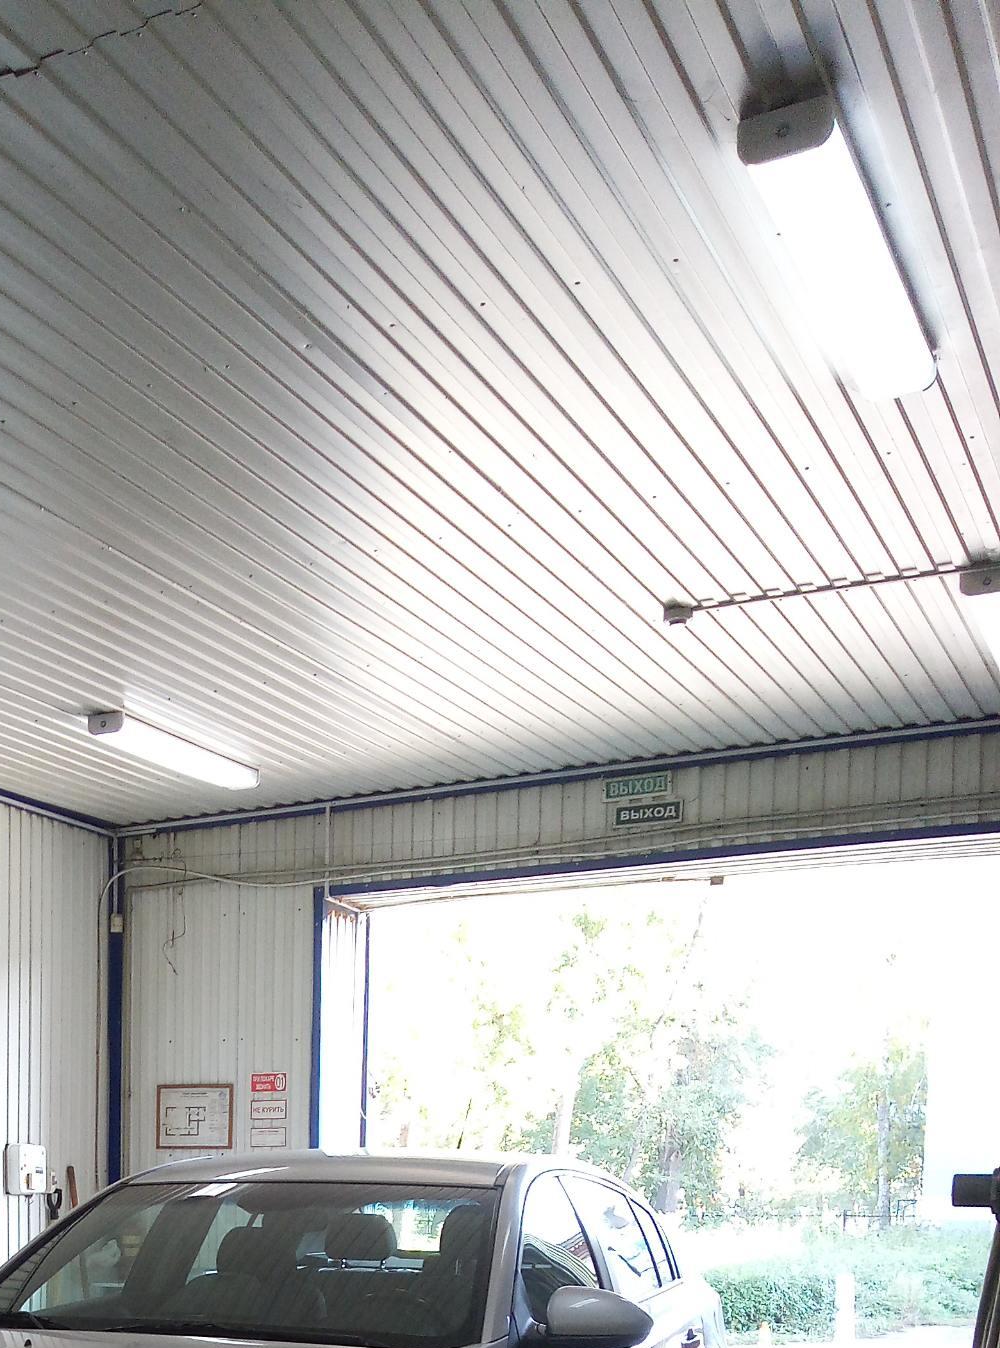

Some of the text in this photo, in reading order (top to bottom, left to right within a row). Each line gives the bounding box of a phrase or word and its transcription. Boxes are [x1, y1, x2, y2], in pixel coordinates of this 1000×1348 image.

[609, 776, 666, 796] ВЫХОД
[620, 805, 677, 821] ВЫХОД
[262, 1105, 285, 1113] КУРИТЬ
